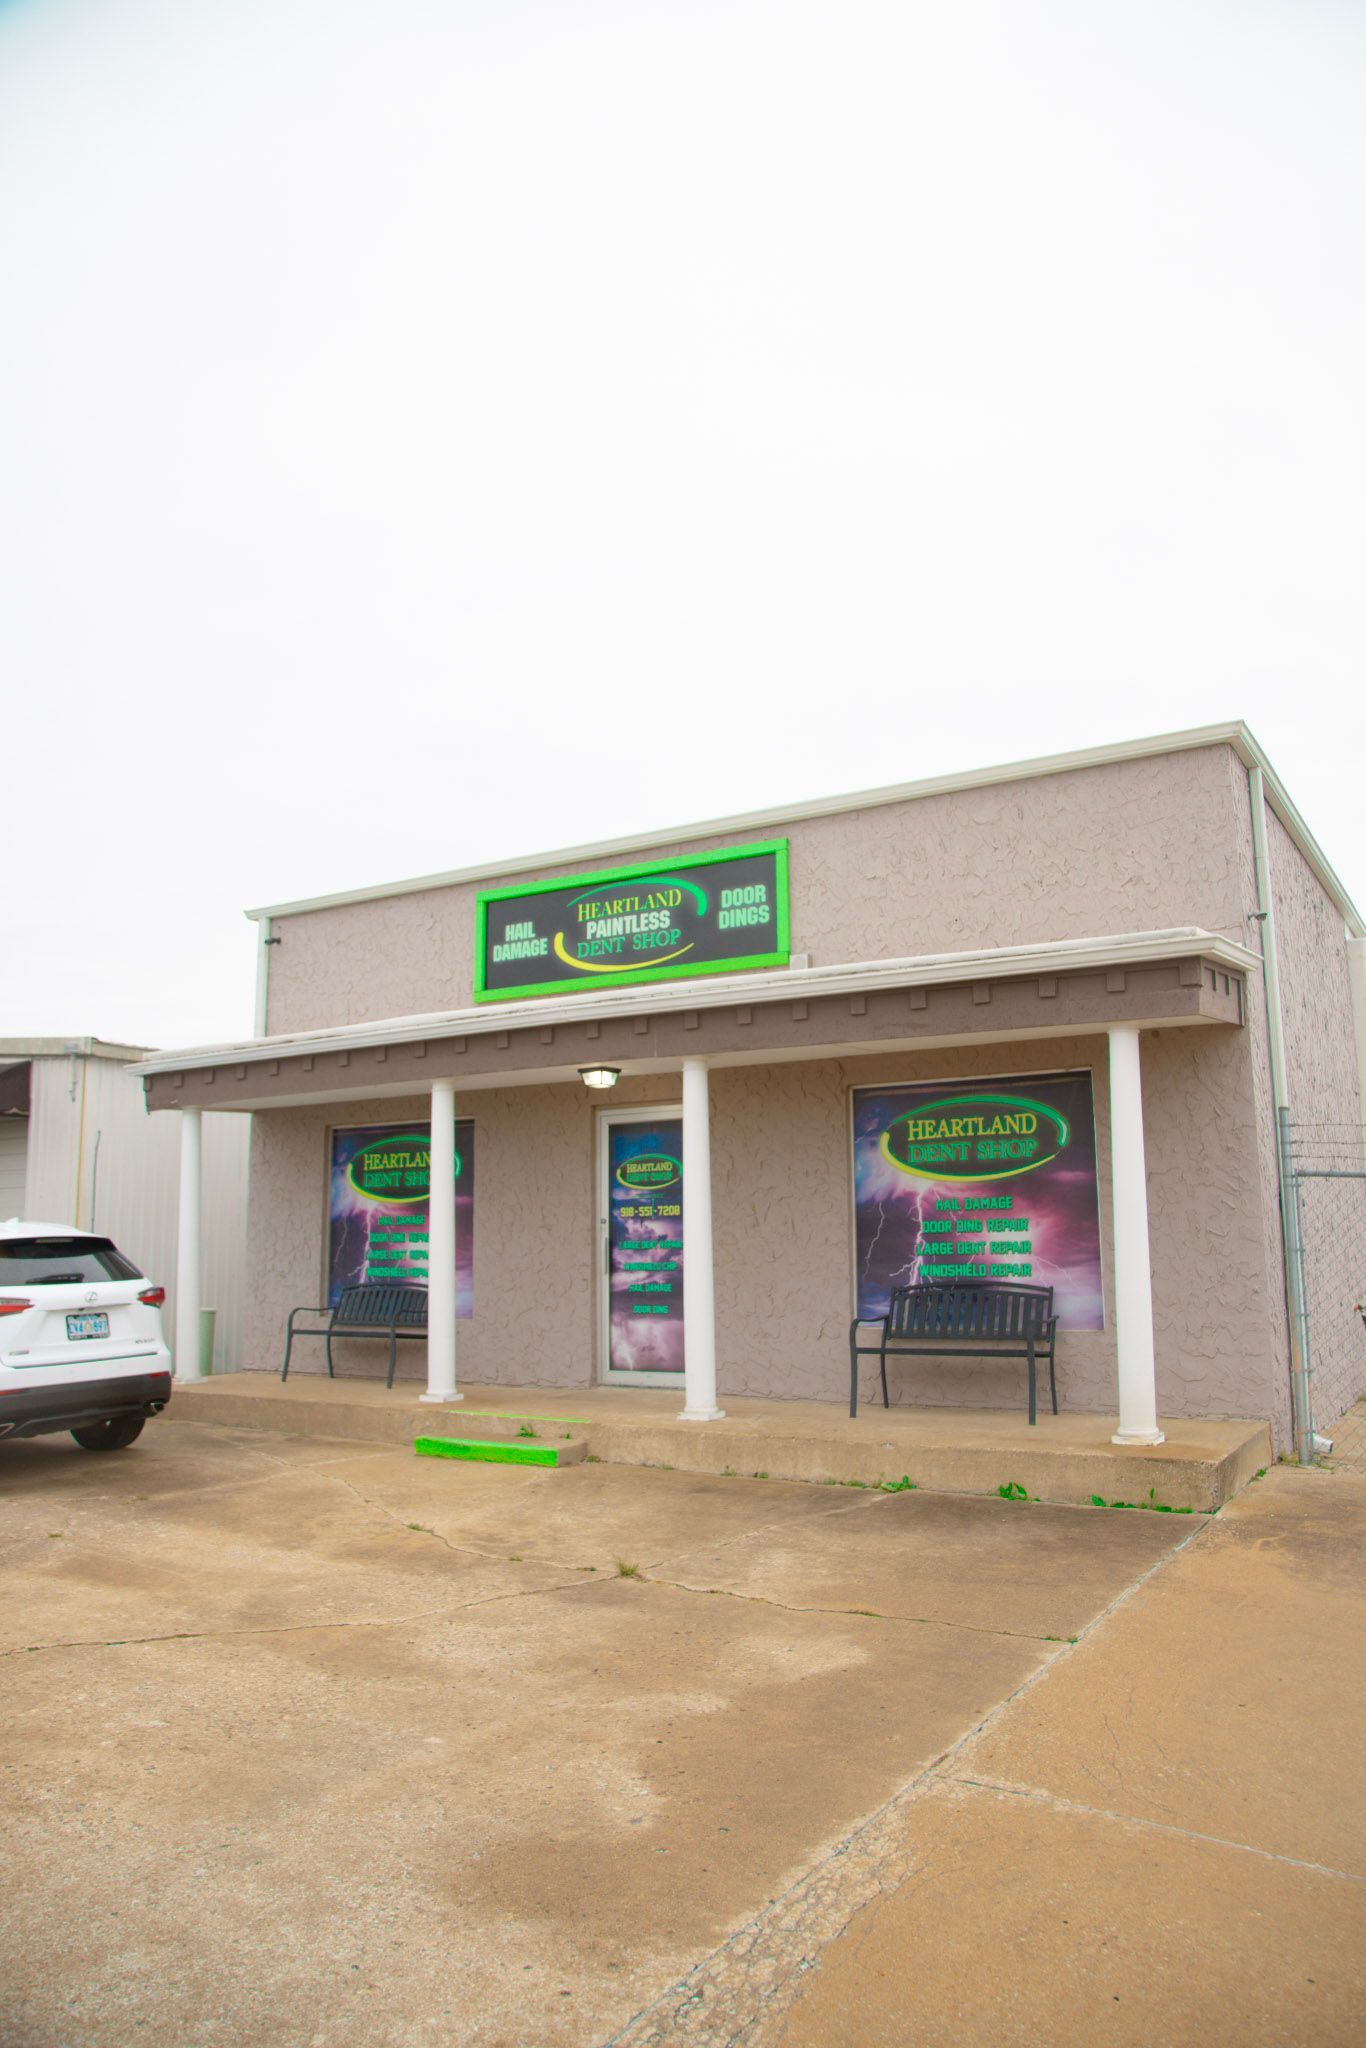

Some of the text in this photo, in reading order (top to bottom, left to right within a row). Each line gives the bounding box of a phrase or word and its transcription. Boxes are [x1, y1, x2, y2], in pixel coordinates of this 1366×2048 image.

[577, 888, 682, 922] HEARTLAND
[721, 884, 766, 908] DOOR
[586, 910, 671, 940] PAINTLESS
[718, 905, 770, 930] DINGS
[505, 921, 535, 942] HAIL
[493, 938, 548, 962] DAMAGE
[577, 928, 682, 959] DENT SHOP
[907, 1112, 1038, 1141] HEARTLAND
[908, 1139, 1038, 1163] DENT SHOP
[363, 1152, 431, 1171] HEARTLAN
[626, 1161, 673, 1173] HEARTLAND
[363, 1170, 431, 1188] DENT SHO
[935, 1196, 1014, 1211] HAIL DAMAGE
[395, 1215, 425, 1226] DAMAGE
[922, 1218, 1029, 1233] DOOR DING REPAIR
[916, 1240, 1032, 1255] LARGE DENT REPAIR
[920, 1263, 1032, 1277] WINDSHIELD REPAIR
[645, 1283, 673, 1293] DAMAGE
